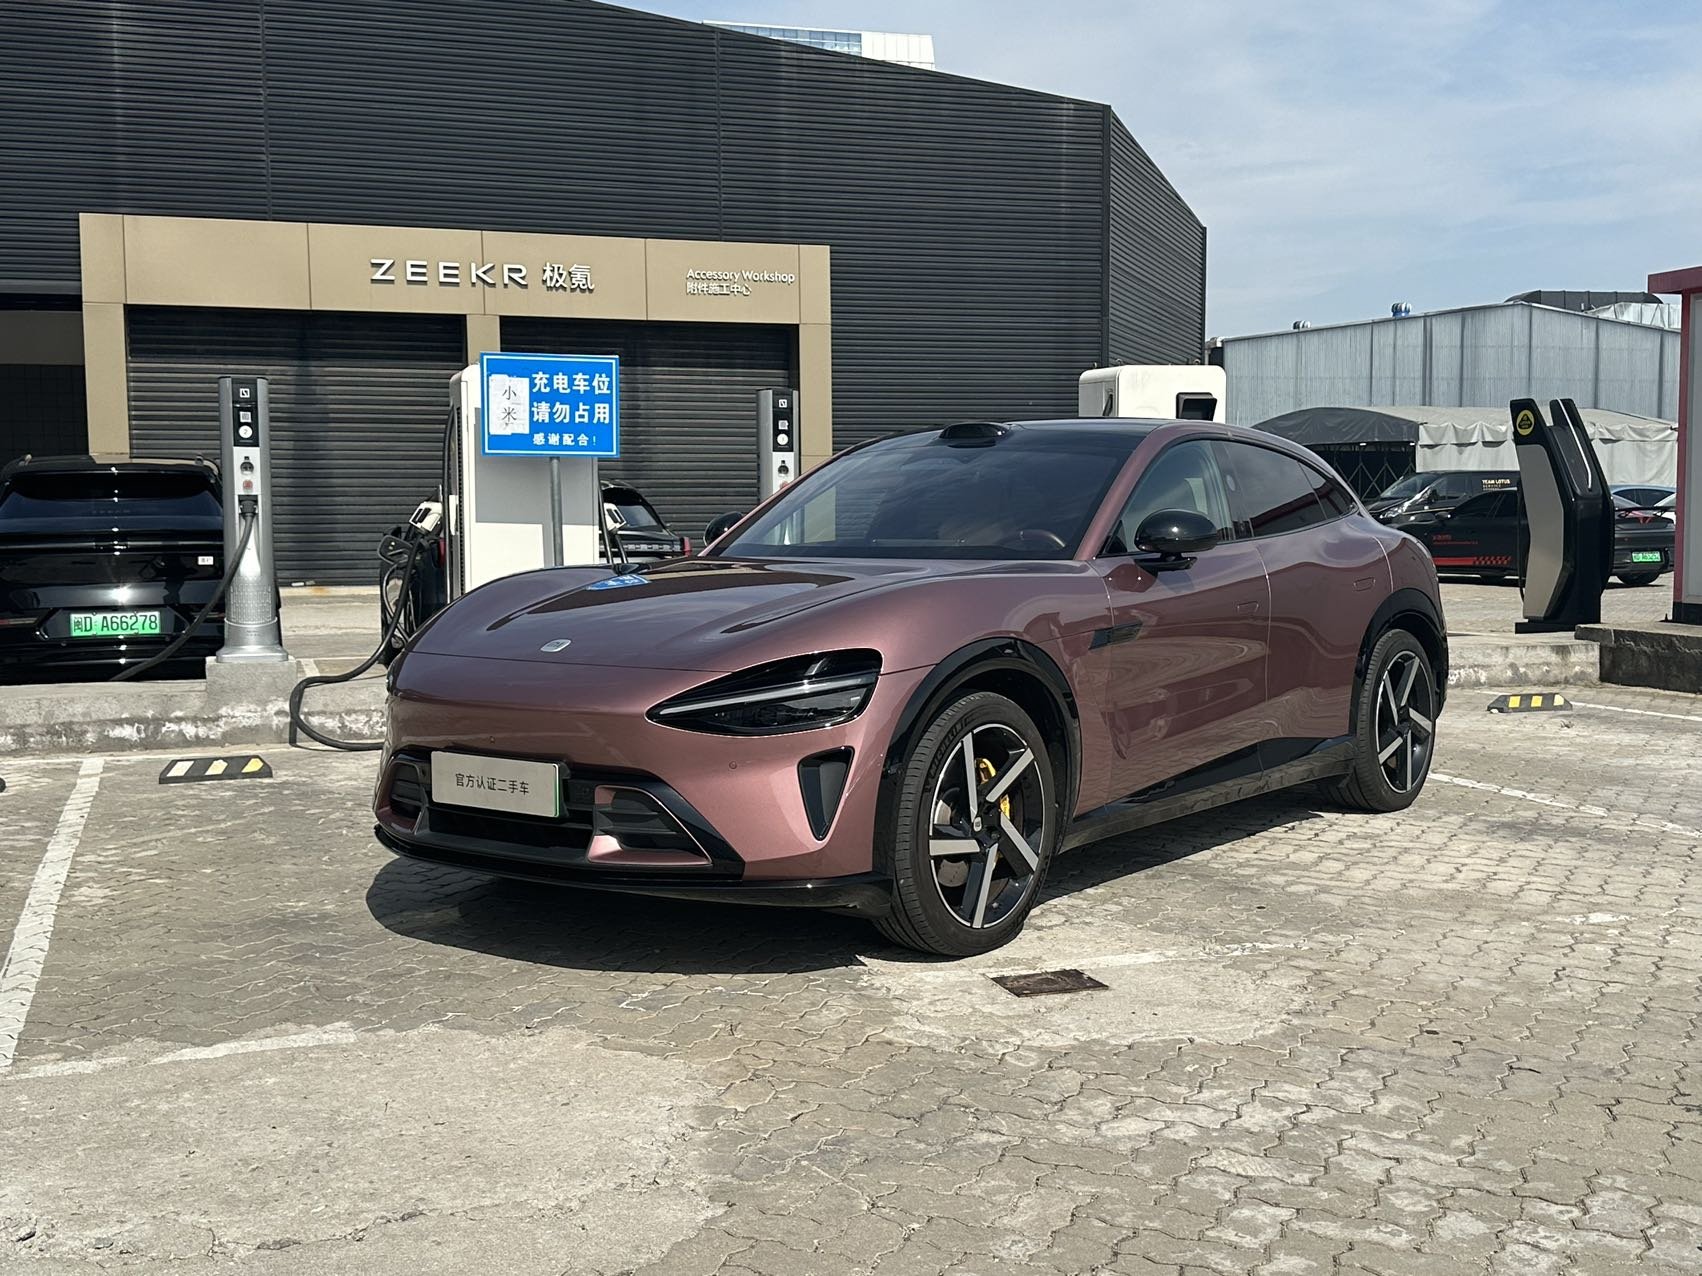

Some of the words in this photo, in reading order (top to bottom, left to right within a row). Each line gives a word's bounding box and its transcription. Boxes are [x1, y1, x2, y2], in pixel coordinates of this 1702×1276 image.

[370, 258, 528, 287] ZEEKR
[542, 261, 595, 291] 极氪
[686, 268, 740, 283] Accessory
[741, 270, 796, 284] Workshop
[686, 281, 752, 296] 附件施工中心
[531, 371, 611, 395] 充电车位
[502, 385, 517, 423] 小米
[531, 401, 610, 424] 请勿占用
[101, 614, 158, 632] A66278
[455, 773, 530, 796] 官方认证二手车
